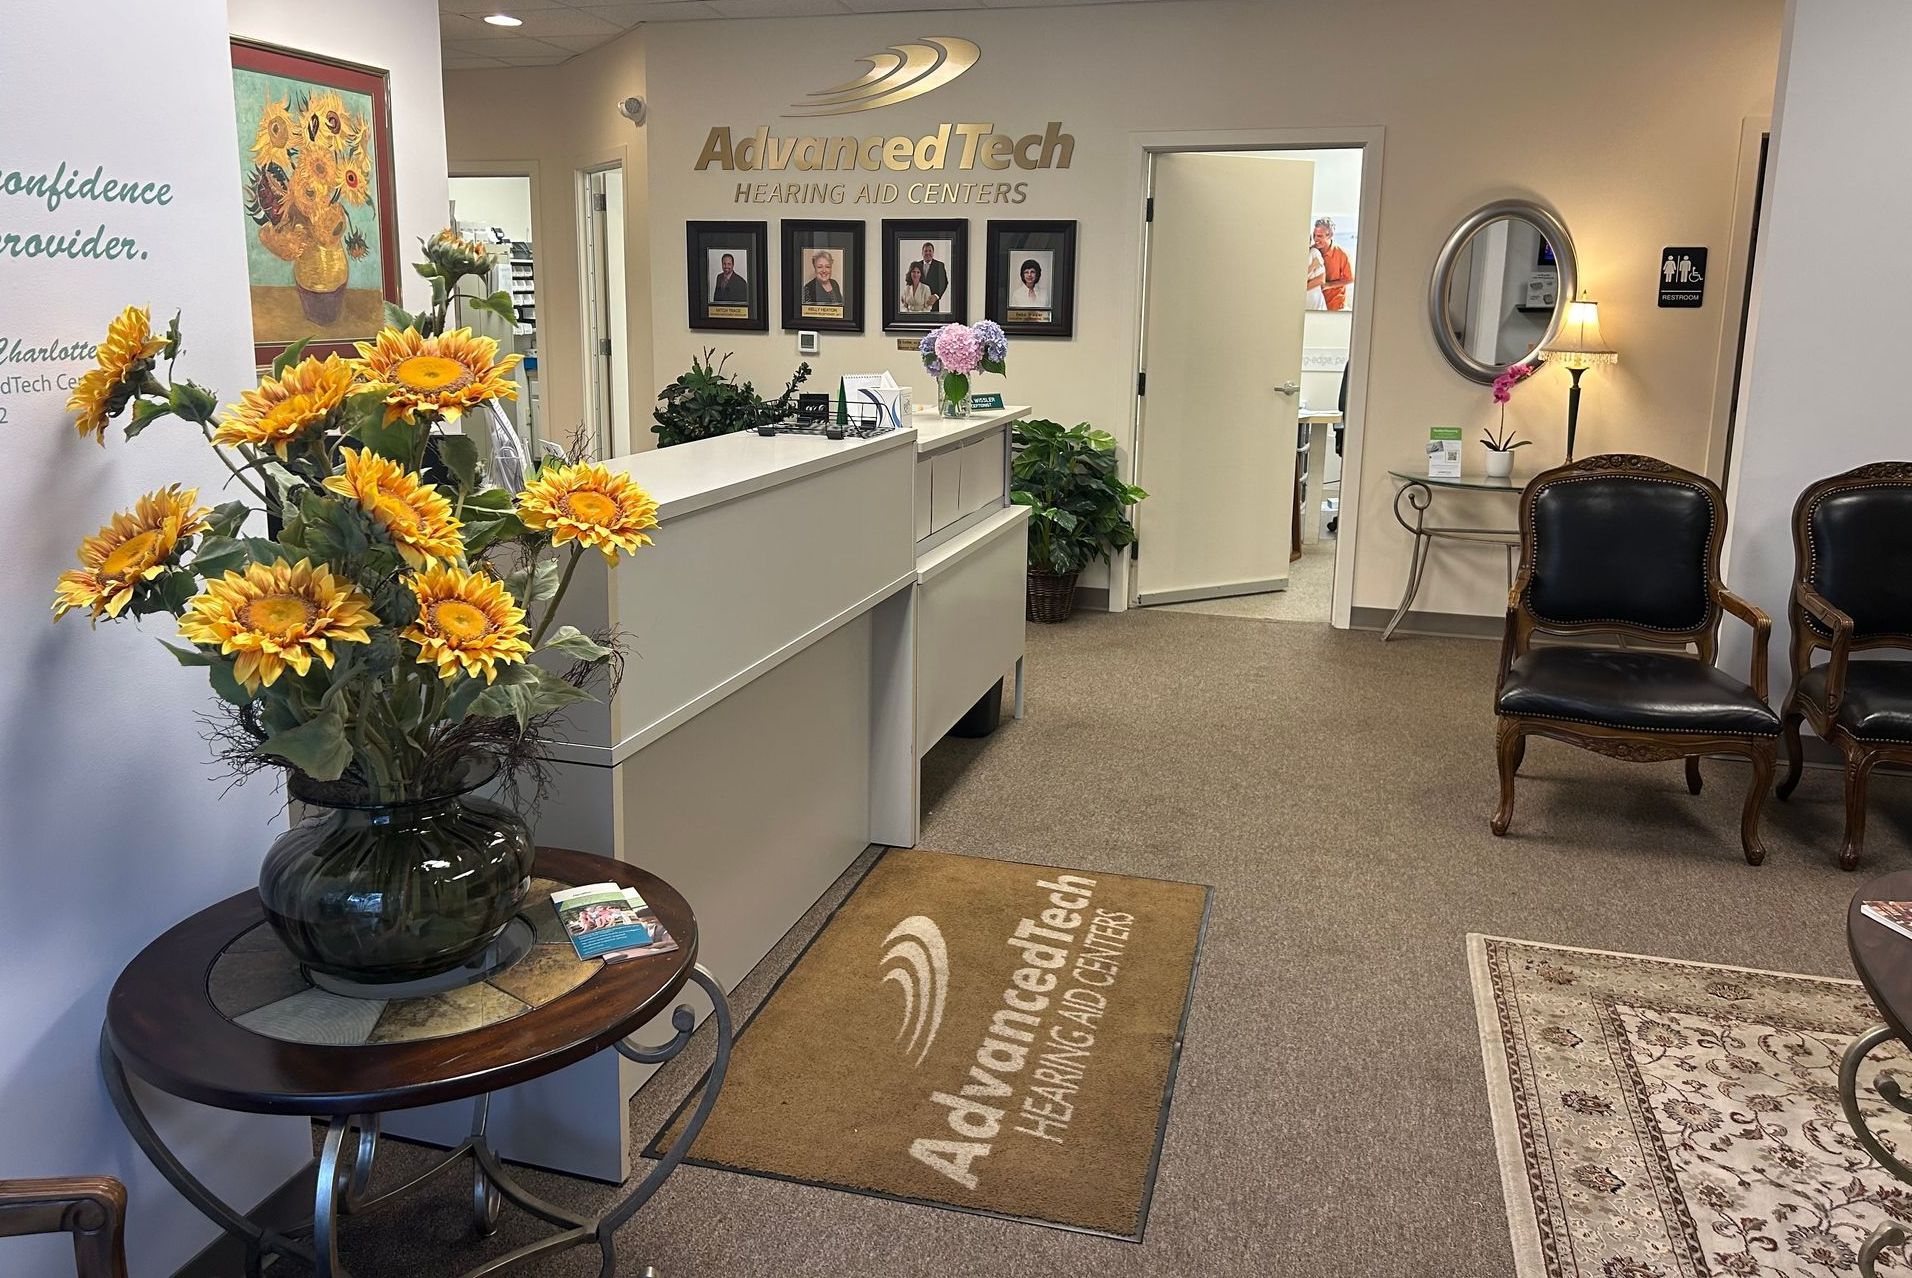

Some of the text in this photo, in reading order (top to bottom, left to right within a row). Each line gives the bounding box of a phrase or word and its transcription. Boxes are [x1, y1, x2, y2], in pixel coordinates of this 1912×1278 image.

[0, 161, 174, 212] onfidence
[734, 182, 1028, 205] HEARING AID CENTERS
[0, 224, 148, 260] rovider.
[908, 874, 1097, 1190] AdvancedTech
[1014, 908, 1135, 1144] HEARING AID CENTERS
